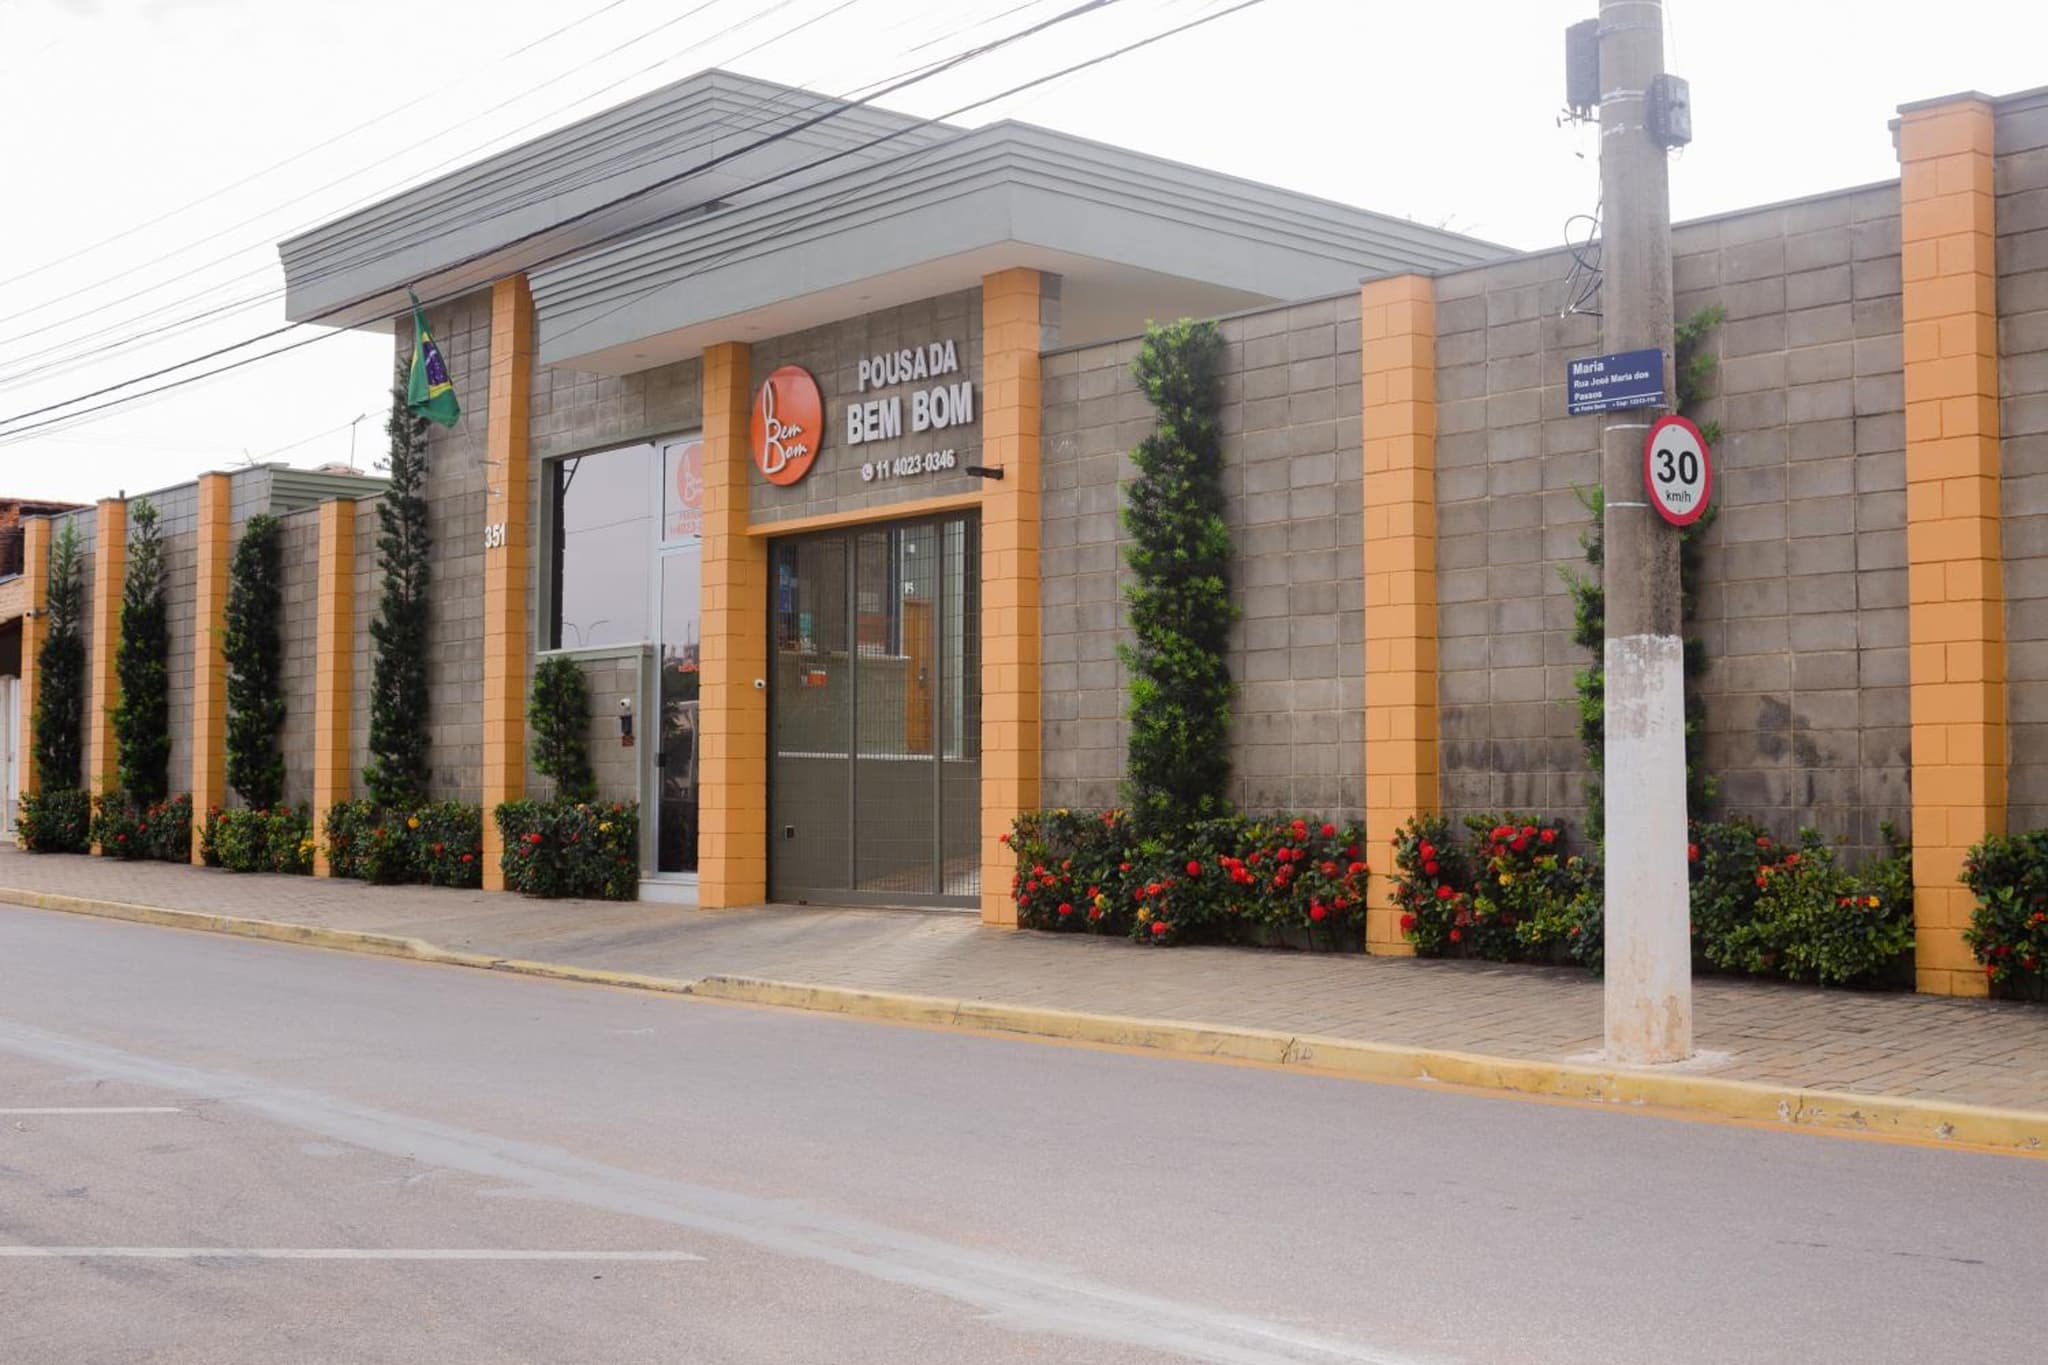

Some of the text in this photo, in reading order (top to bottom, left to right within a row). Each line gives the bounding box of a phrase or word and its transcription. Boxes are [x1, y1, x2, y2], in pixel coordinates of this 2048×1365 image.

[858, 339, 959, 393] POUSADA
[1573, 360, 1604, 375] Maria
[1574, 370, 1649, 388] Rua José Maria dos
[1574, 391, 1603, 401] Passos
[763, 380, 803, 442] Bem
[848, 380, 974, 445] BEM BOM
[876, 448, 955, 479] 11 4023-0346
[1656, 449, 1698, 485] 30
[1665, 491, 1692, 503] km/h
[484, 522, 506, 549] 351
